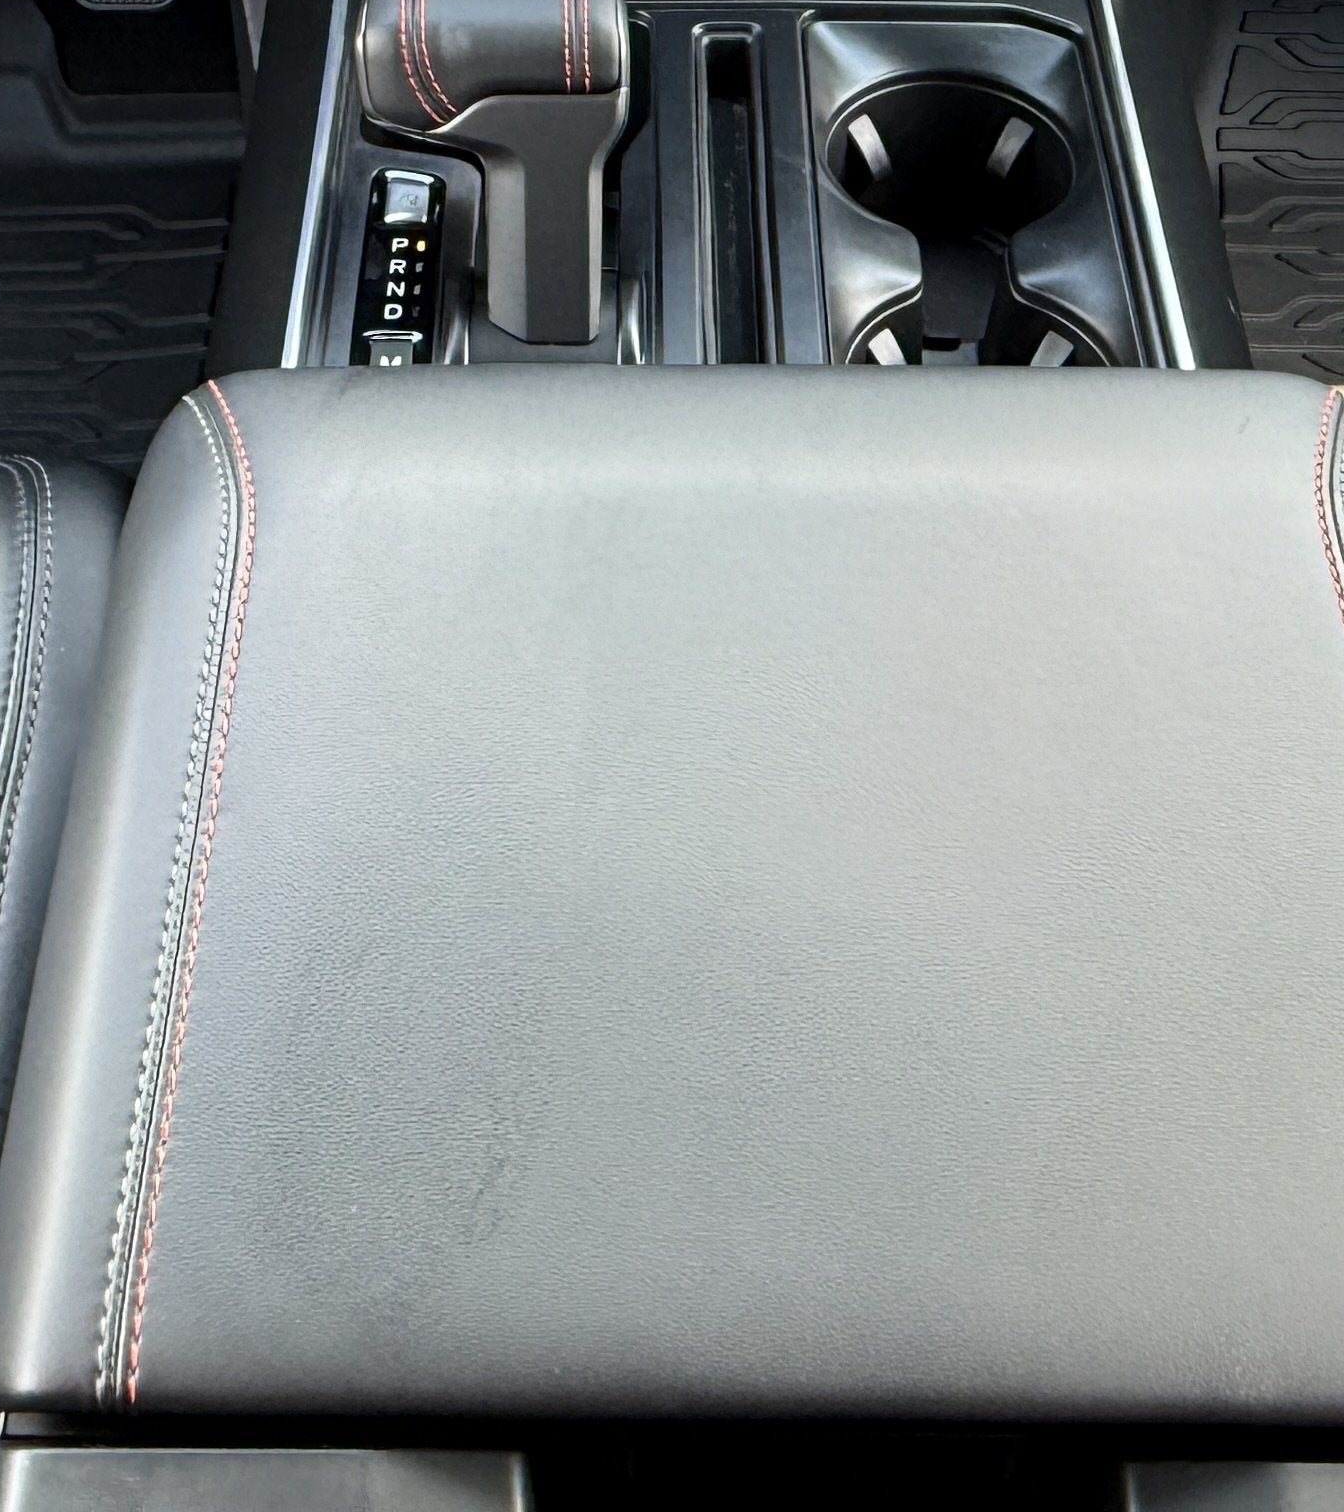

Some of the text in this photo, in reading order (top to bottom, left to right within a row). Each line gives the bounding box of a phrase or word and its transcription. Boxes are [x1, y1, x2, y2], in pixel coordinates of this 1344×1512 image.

[391, 237, 410, 253] P
[388, 259, 407, 275] R
[385, 281, 406, 297] N
[383, 303, 404, 321] D
